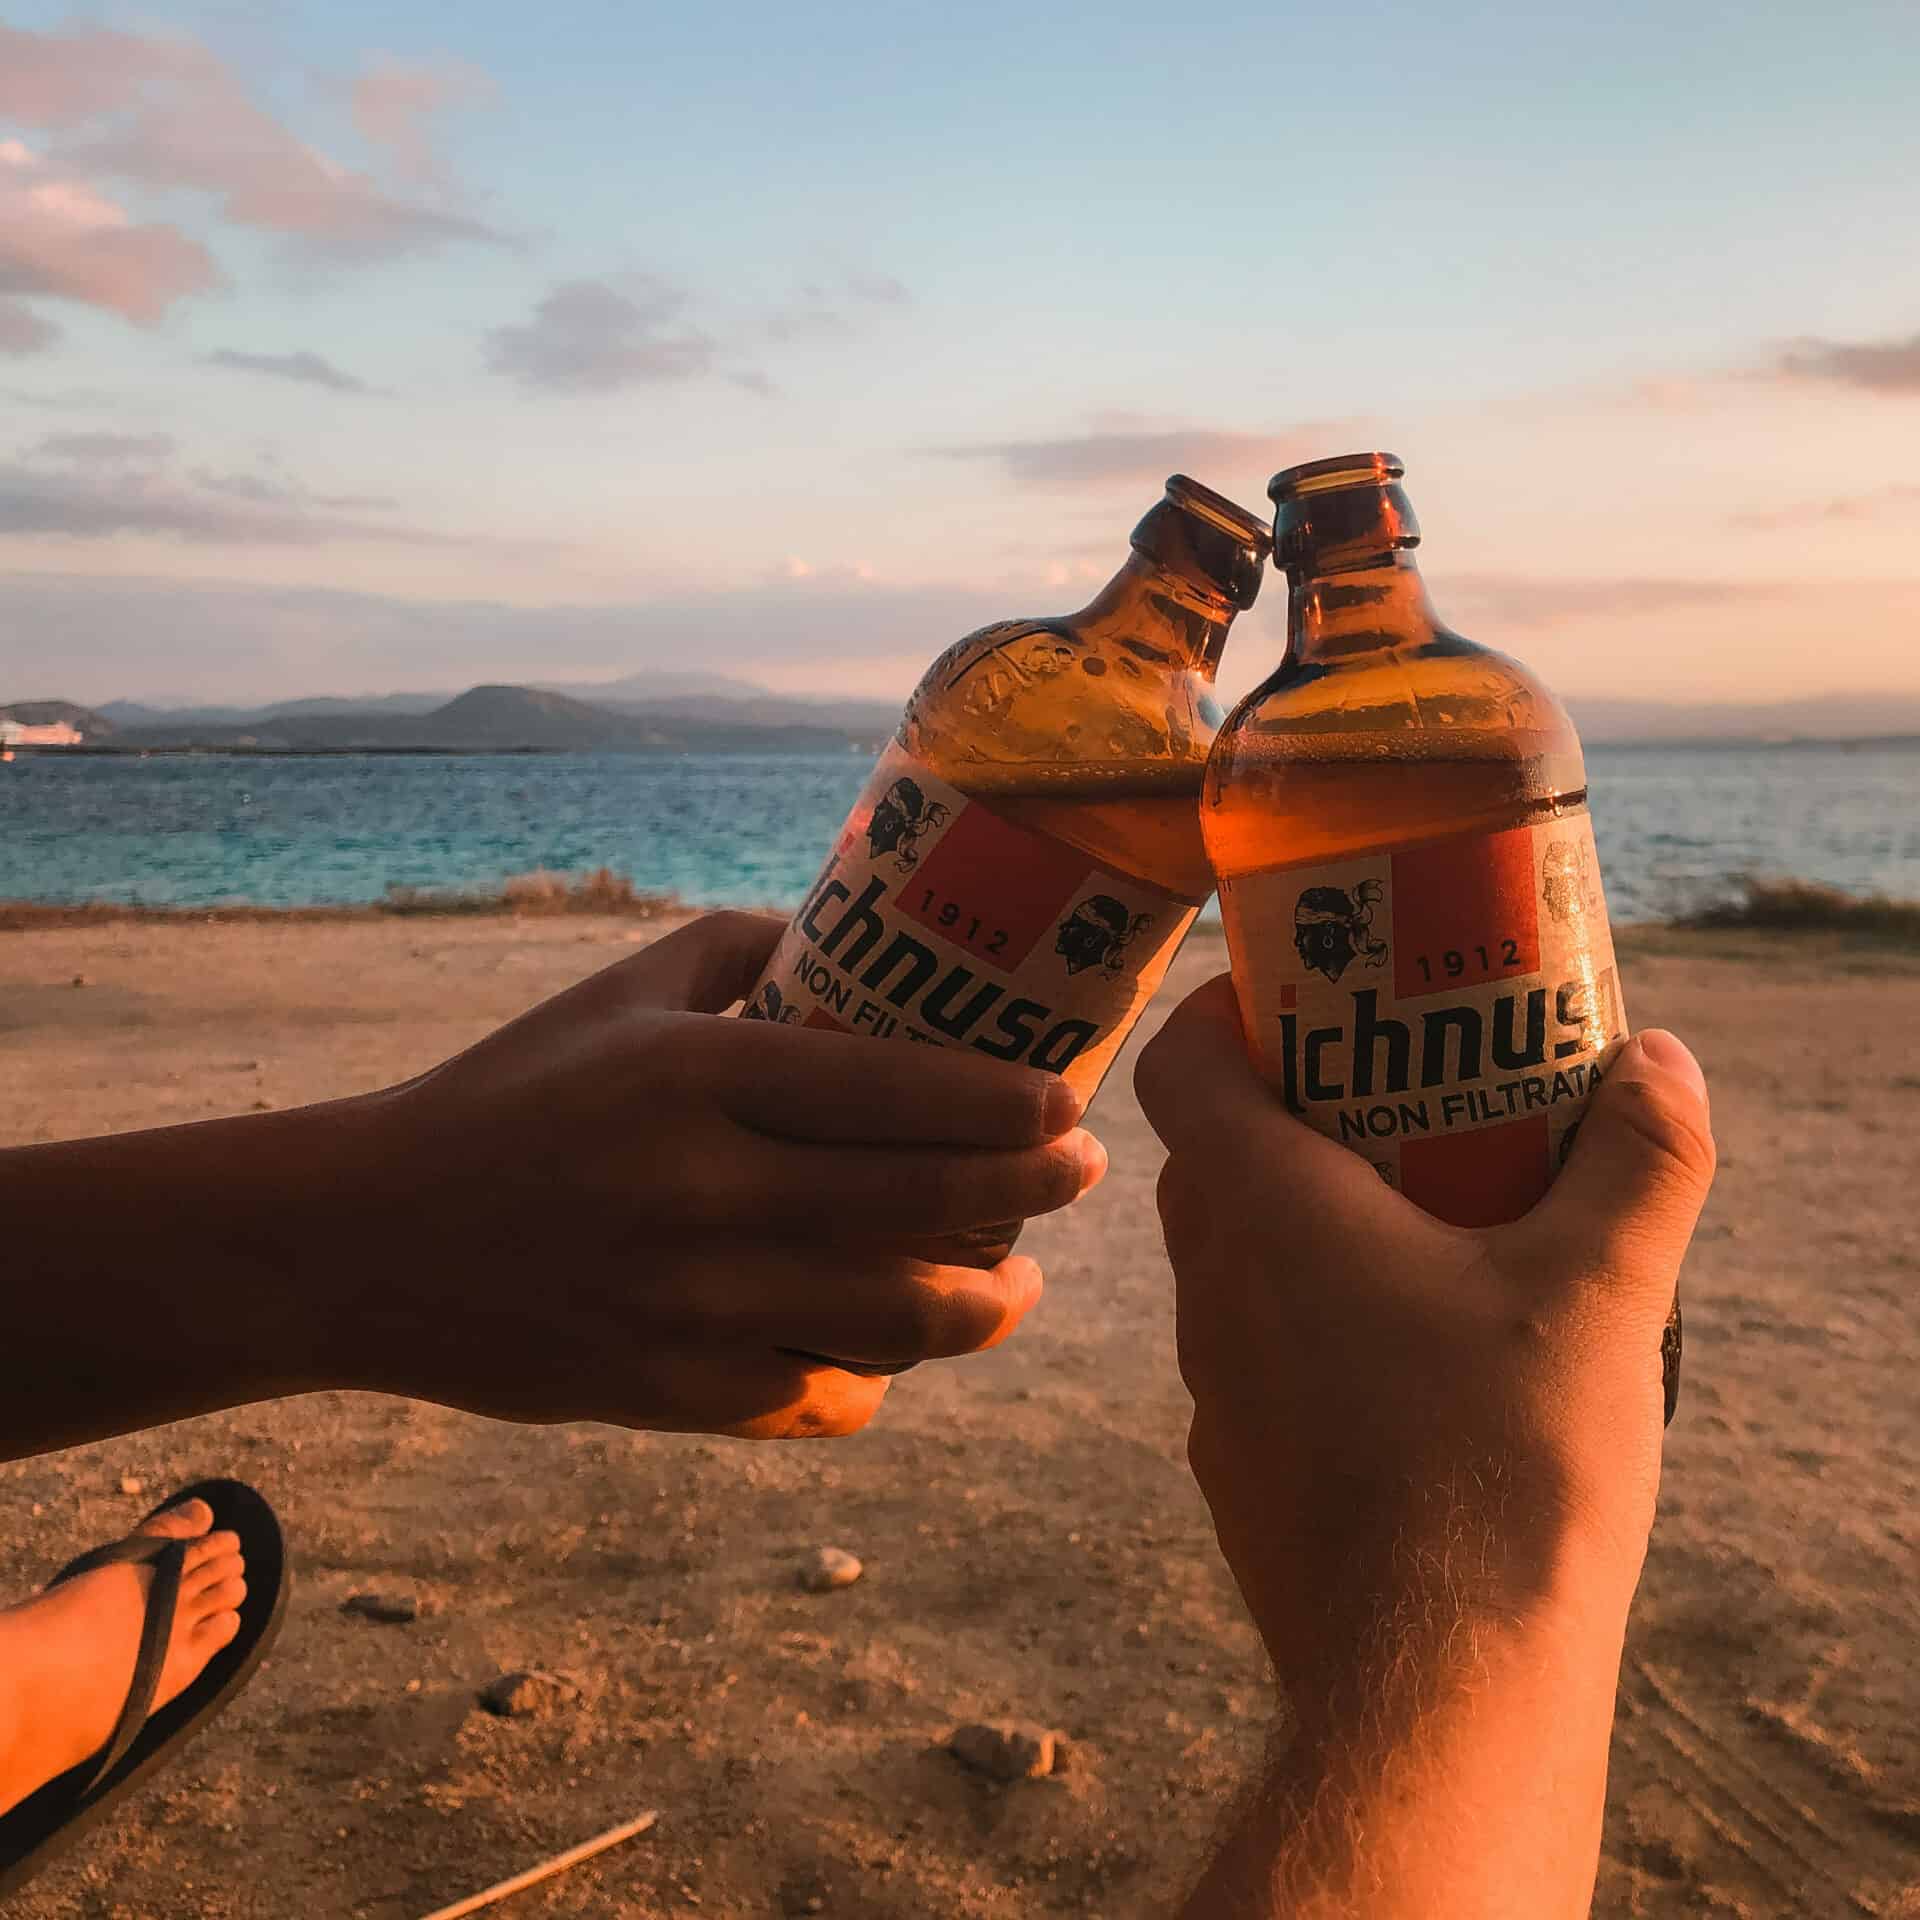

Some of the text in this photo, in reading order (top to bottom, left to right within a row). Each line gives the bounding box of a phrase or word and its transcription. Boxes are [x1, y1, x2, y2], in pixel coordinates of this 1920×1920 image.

[919, 889, 1010, 955] 1912
[794, 950, 853, 1014] NON
[1417, 938, 1522, 983] 1912
[1338, 1063, 1602, 1142] NON FILTRATA
